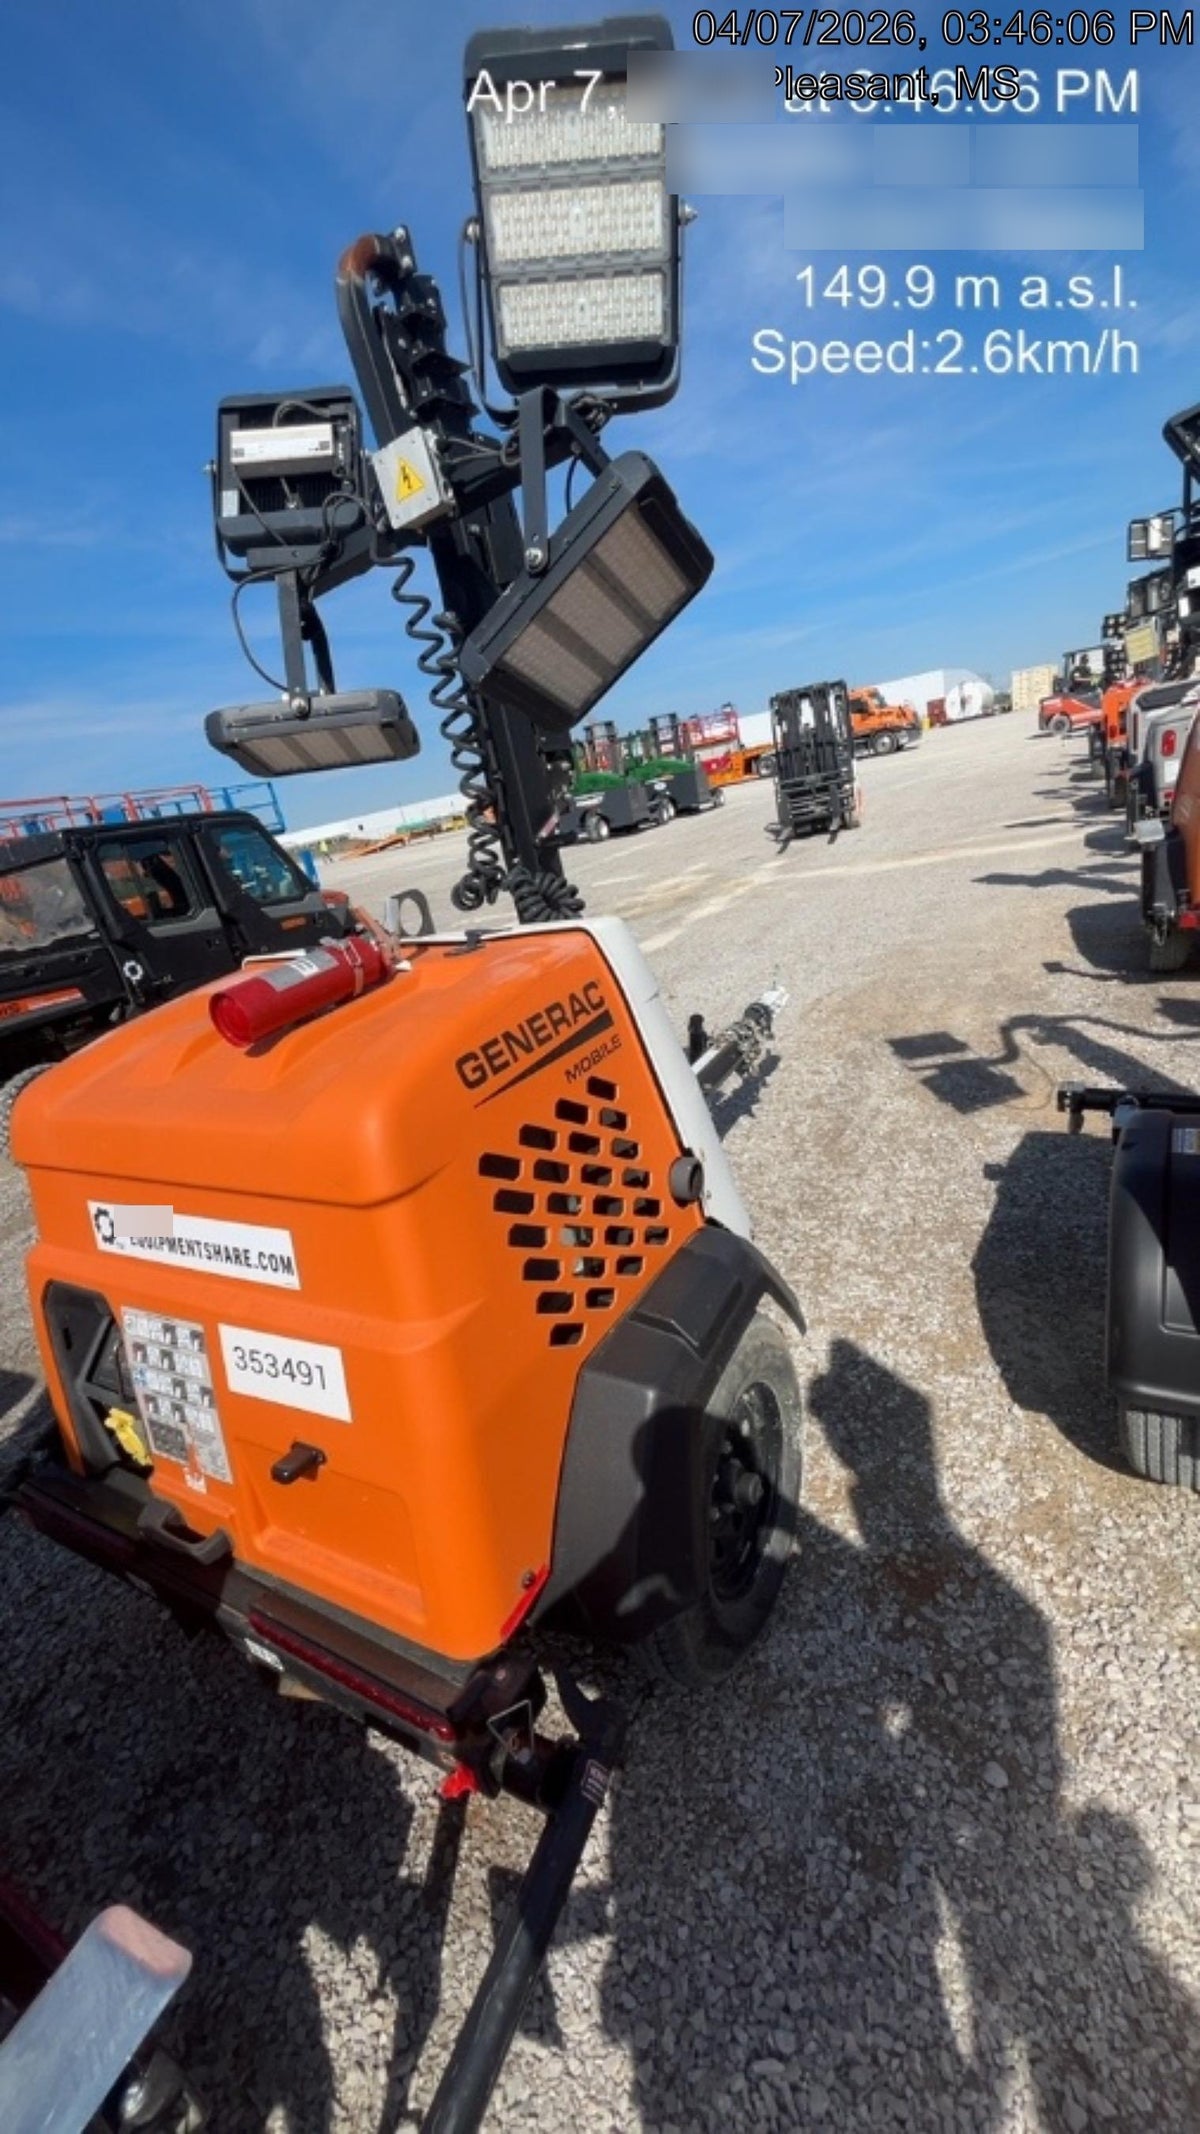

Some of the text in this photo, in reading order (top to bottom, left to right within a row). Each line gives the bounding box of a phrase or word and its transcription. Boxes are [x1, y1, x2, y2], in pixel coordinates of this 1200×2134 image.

[455, 981, 606, 1089] GENERAC
[564, 1034, 622, 1084] MOBILE
[232, 1346, 327, 1390] 353491
